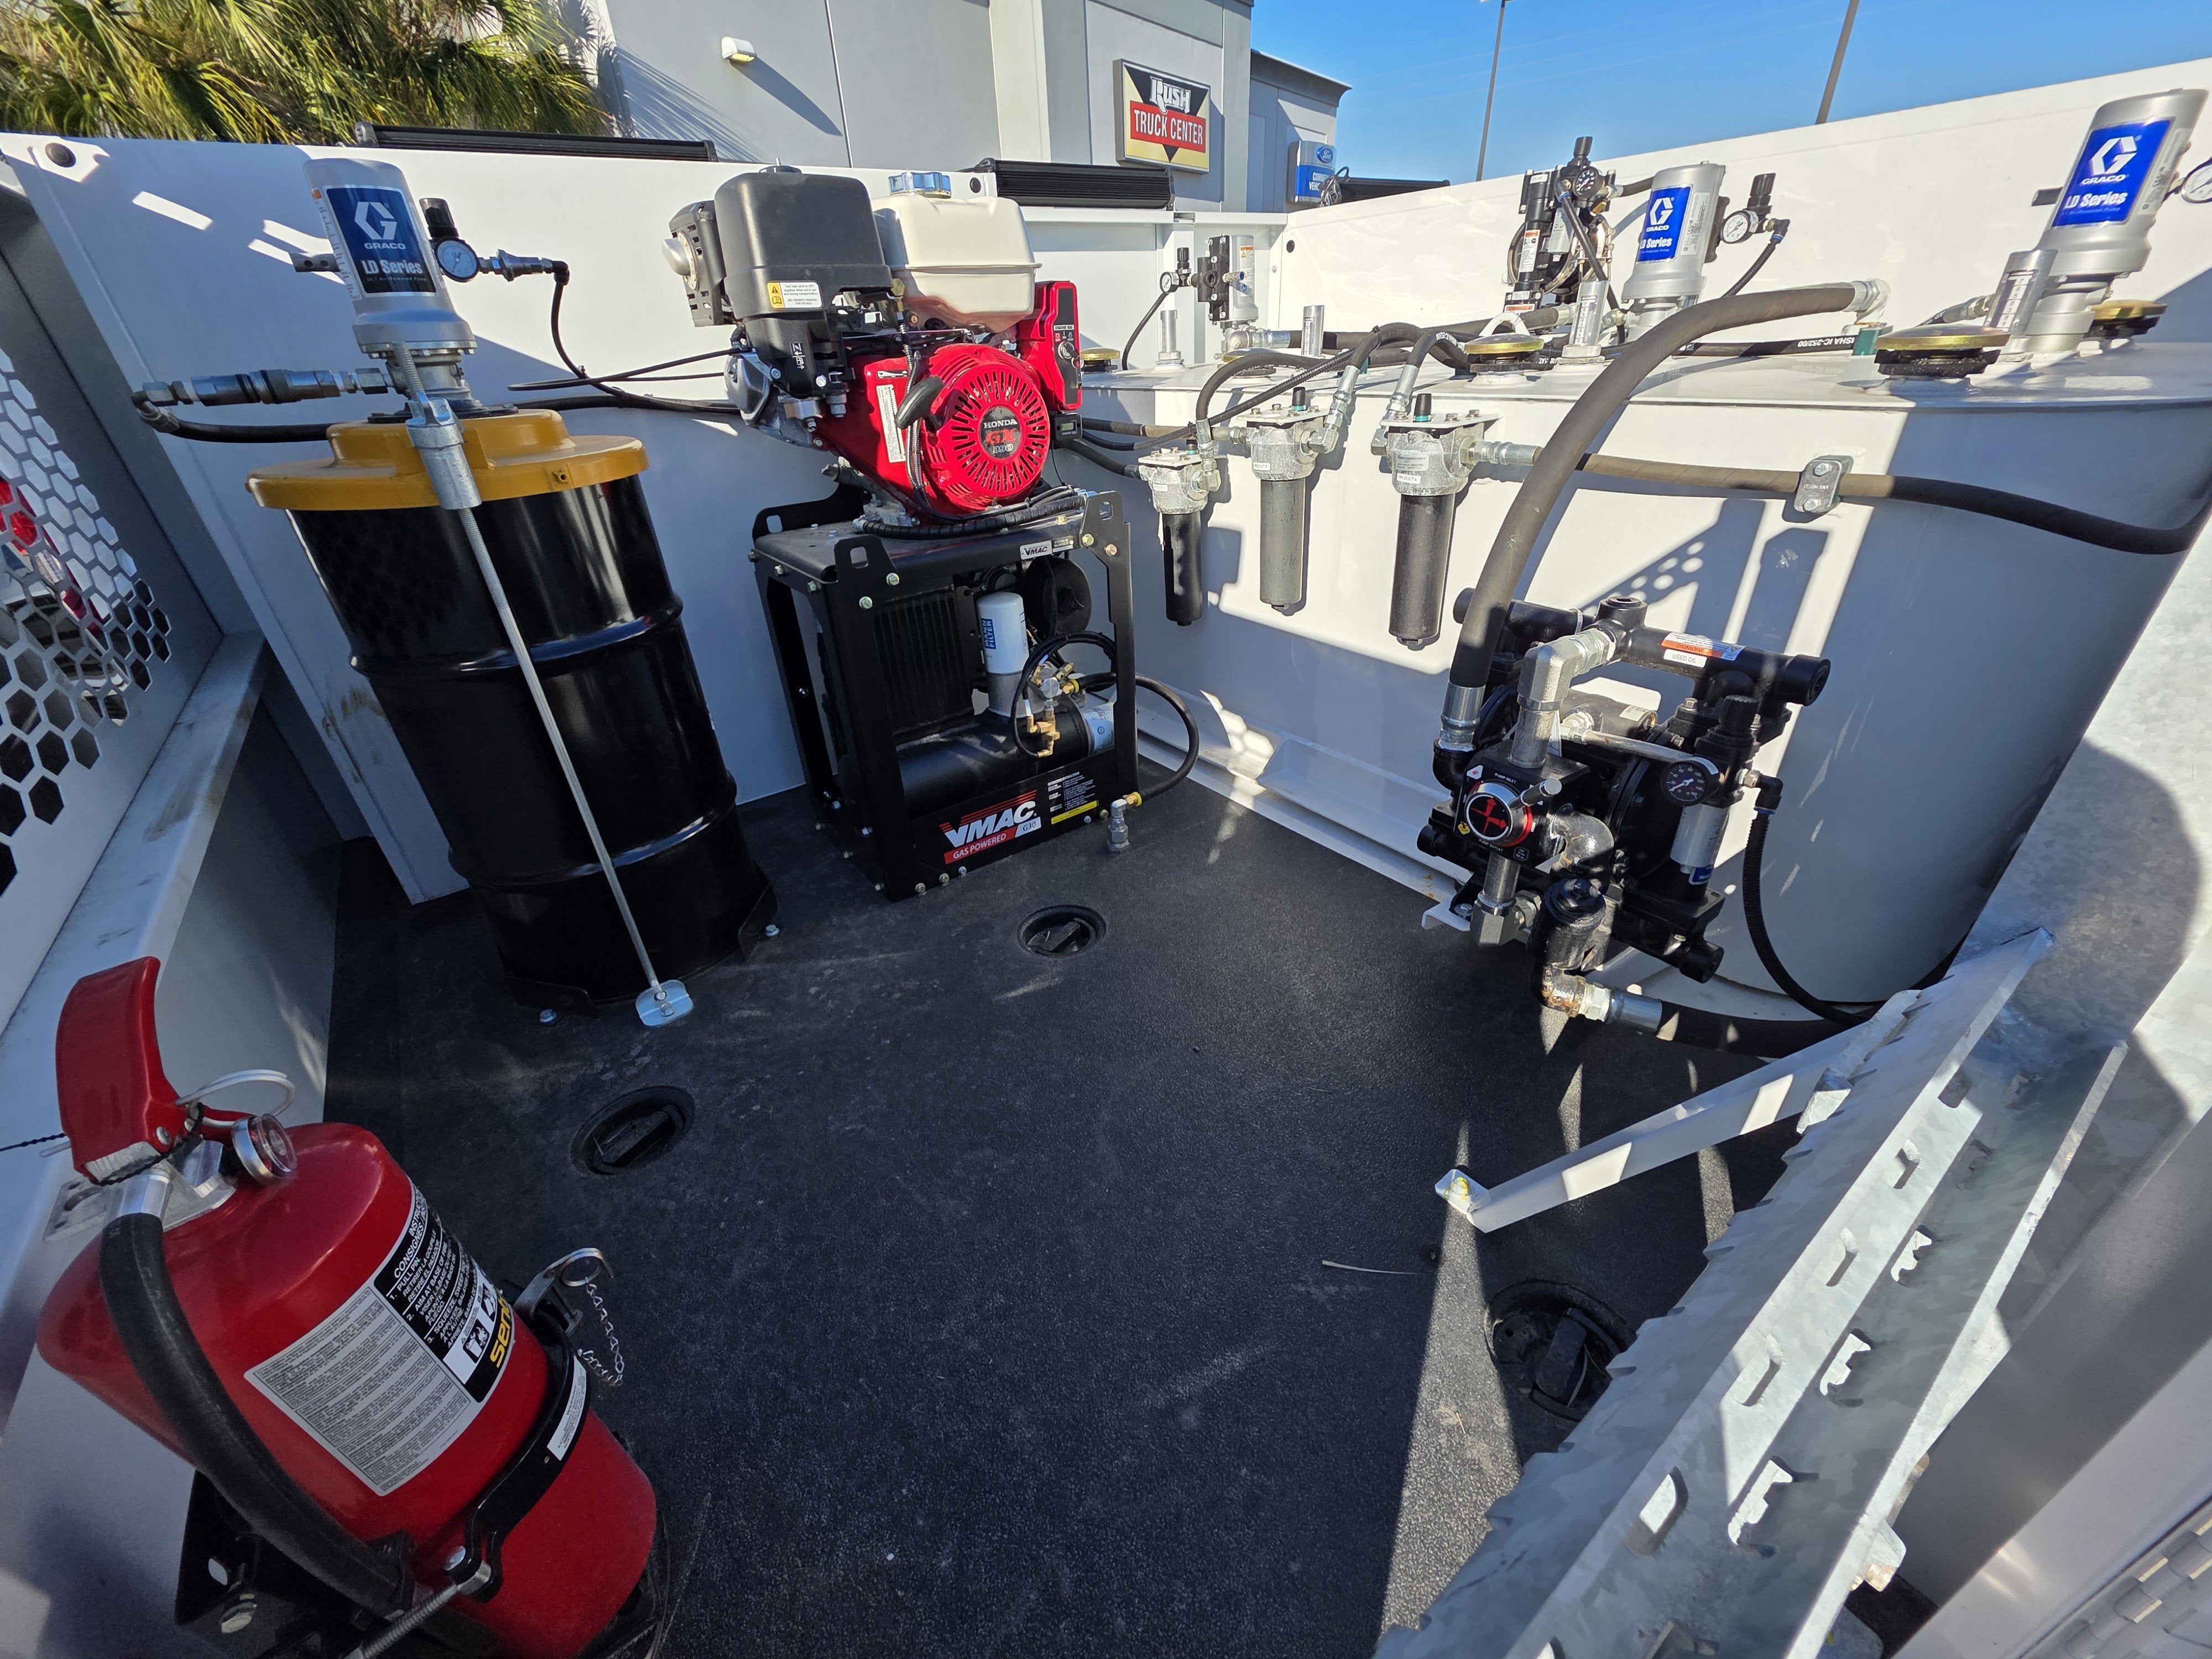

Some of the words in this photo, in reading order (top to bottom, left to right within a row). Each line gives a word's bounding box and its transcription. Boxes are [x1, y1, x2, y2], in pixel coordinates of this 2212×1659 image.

[1150, 76, 1191, 114] RUSH
[1134, 109, 1167, 137] TRUCK
[1171, 117, 1203, 145] CENTER
[1323, 150, 1331, 159] Ford
[2081, 175, 2126, 185] GRACO
[2064, 195, 2080, 209] LD
[2080, 191, 2128, 207] Series
[1646, 237, 1672, 248] Series
[362, 260, 379, 274] LD
[380, 259, 423, 274] Series
[984, 419, 1018, 429] HONDA
[986, 428, 1016, 444] GX
[1024, 547, 1047, 555] VMAC
[1676, 643, 1704, 653] WARNING
[945, 801, 1036, 848] VMAC
[1022, 821, 1036, 831] G30
[953, 847, 969, 859] GAS
[970, 833, 1006, 853] POWERED
[394, 1222, 424, 1279] CONSIGNES
[397, 1272, 413, 1291] PULL
[410, 1257, 421, 1271] PIN.
[403, 1267, 423, 1297] RETIRER
[421, 1259, 427, 1268] LA
[408, 1276, 424, 1303] RETIRE
[423, 1269, 431, 1279] EL
[415, 1295, 426, 1311] AIM
[424, 1285, 434, 1296] AT
[430, 1265, 442, 1286] BASE
[439, 1255, 445, 1266] OF
[455, 1273, 465, 1297] SWEEP
[420, 1295, 435, 1316] VISER
[437, 1269, 447, 1287] BASE
[425, 1294, 443, 1322] APUNTE
[444, 1280, 450, 1289] LA
[428, 1301, 446, 1326] FUEGO.
